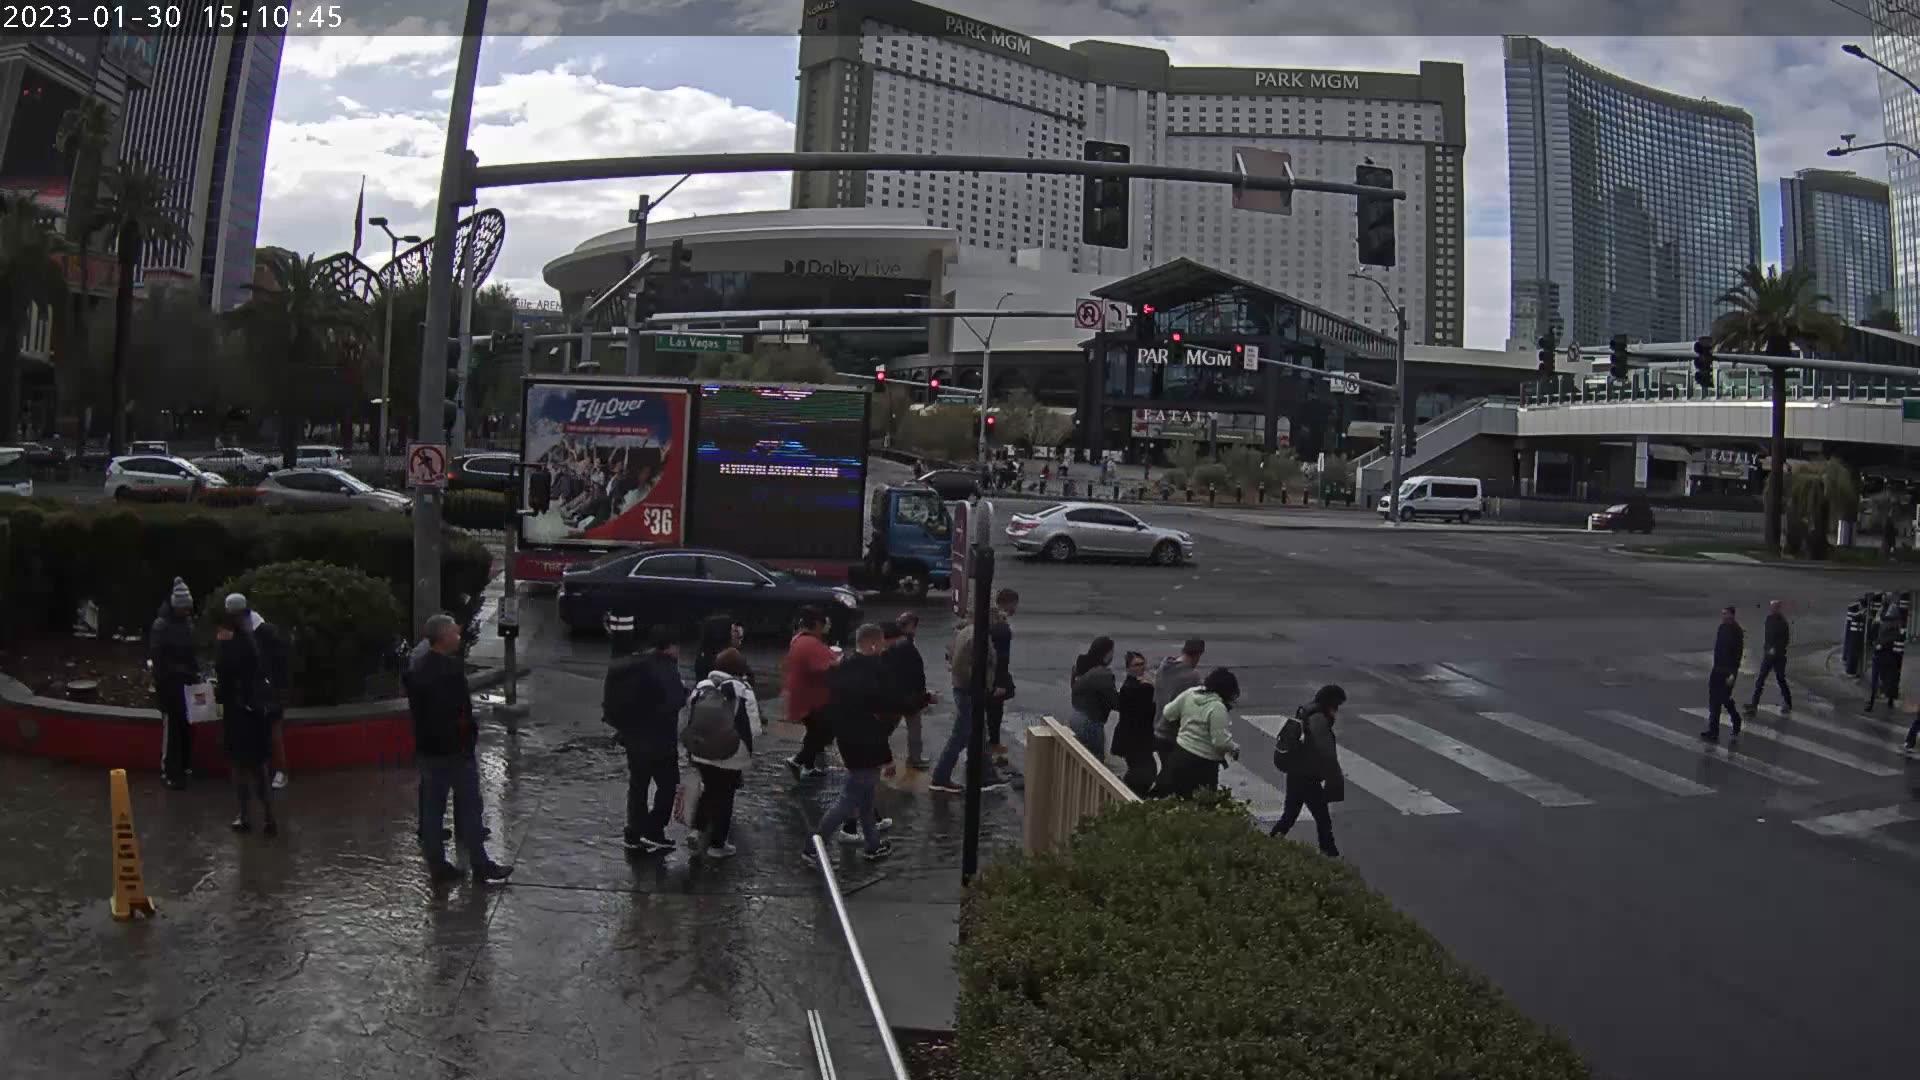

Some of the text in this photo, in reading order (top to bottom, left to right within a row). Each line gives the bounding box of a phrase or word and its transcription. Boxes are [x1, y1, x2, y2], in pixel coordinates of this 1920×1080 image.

[945, 15, 1031, 56] PARK MGM
[1255, 71, 1359, 89] PARK MGM
[808, 259, 901, 279] Dolby Live
[669, 336, 687, 347] Las
[690, 337, 719, 350] Vegas
[1137, 348, 1169, 365] PAR
[1186, 349, 1231, 366] MGM
[570, 397, 645, 426] FlyOver
[643, 507, 673, 536] $36
